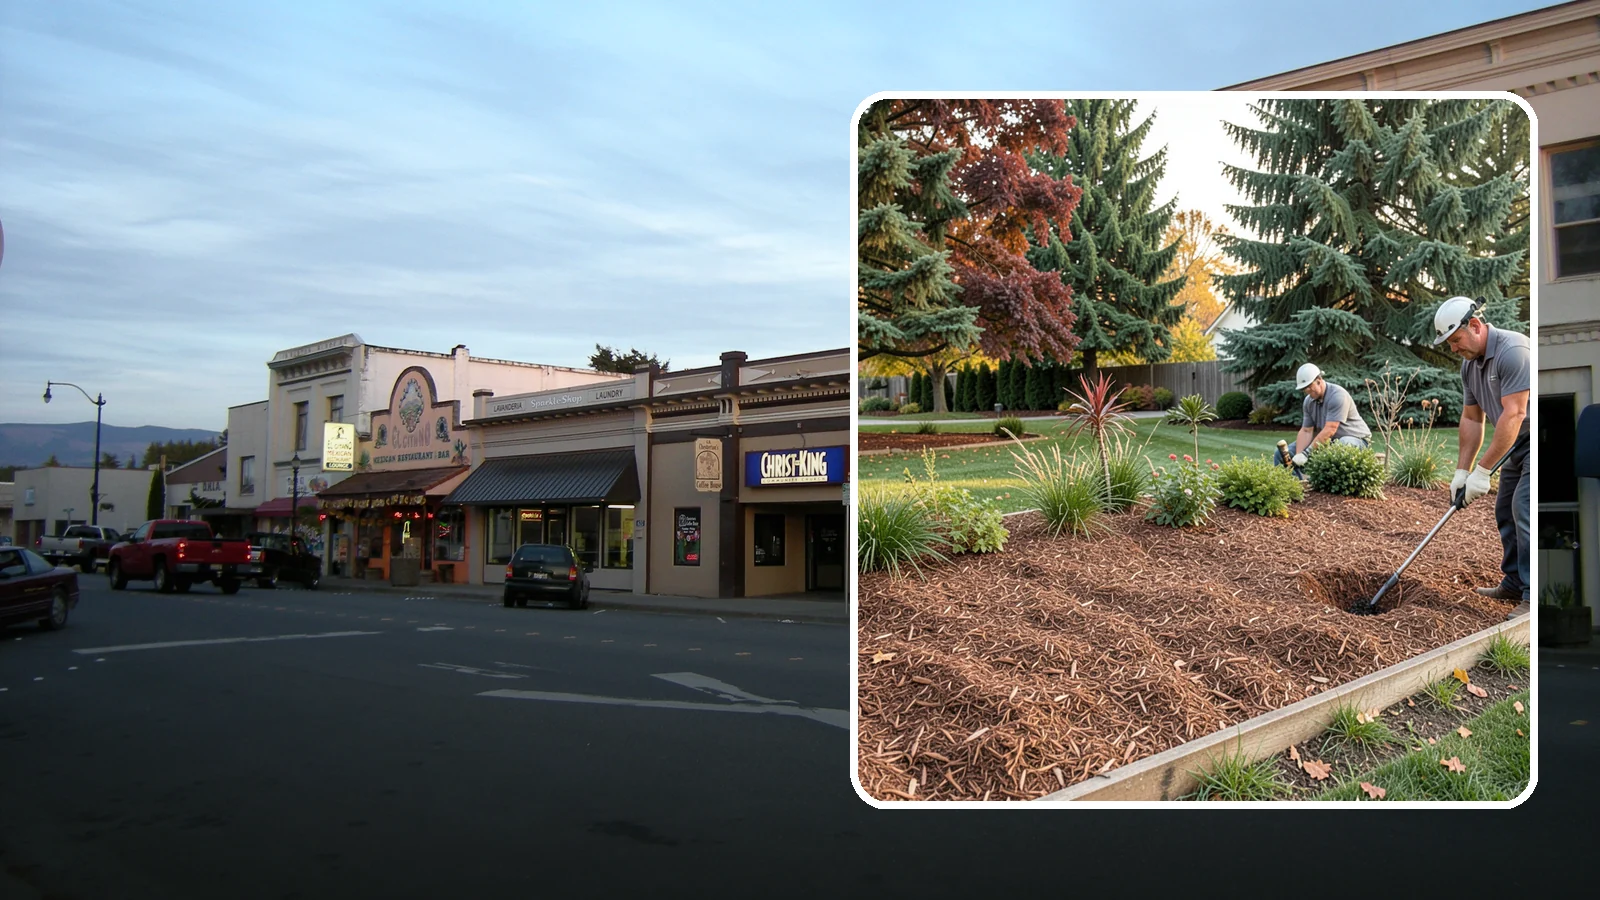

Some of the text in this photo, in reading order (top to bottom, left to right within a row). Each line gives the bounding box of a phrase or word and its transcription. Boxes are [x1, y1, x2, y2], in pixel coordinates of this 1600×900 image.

[530, 394, 583, 409] Sparkle Shop
[596, 389, 624, 400] LAUNDRY
[494, 402, 523, 412] LAVANDERIA
[392, 425, 402, 449] EL
[374, 455, 396, 464] MEXICAN
[398, 451, 433, 462] RESTAURANT
[438, 450, 450, 458] BAR
[761, 450, 827, 478] CHRIST KING
[710, 480, 722, 488] House
